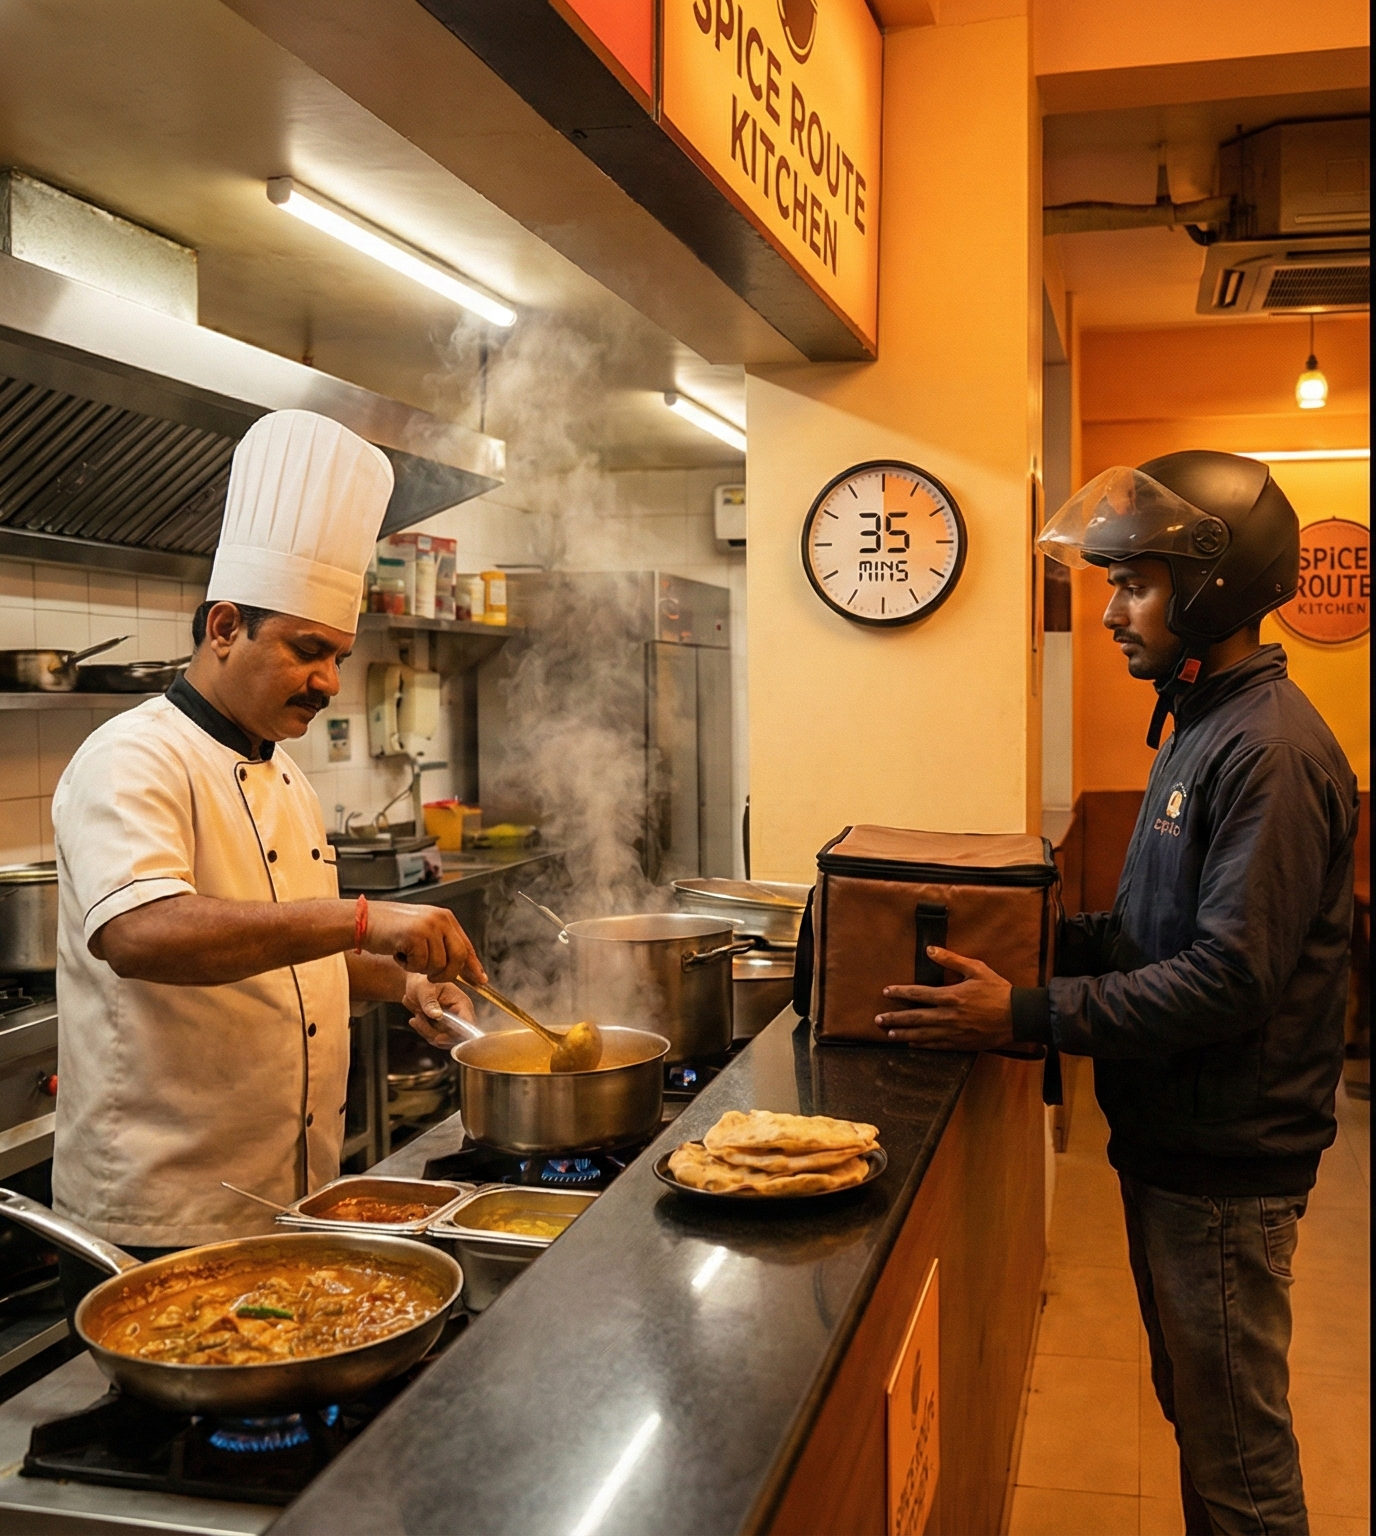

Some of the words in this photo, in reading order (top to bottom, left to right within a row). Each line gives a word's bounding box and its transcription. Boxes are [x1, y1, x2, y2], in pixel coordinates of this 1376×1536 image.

[790, 81, 867, 236] ROUTE
[731, 93, 838, 277] KITCHEN
[859, 512, 910, 553] 35
[859, 560, 909, 582] MINS
[1299, 574, 1370, 598] ROUTE
[1298, 603, 1366, 614] KITCHEN
